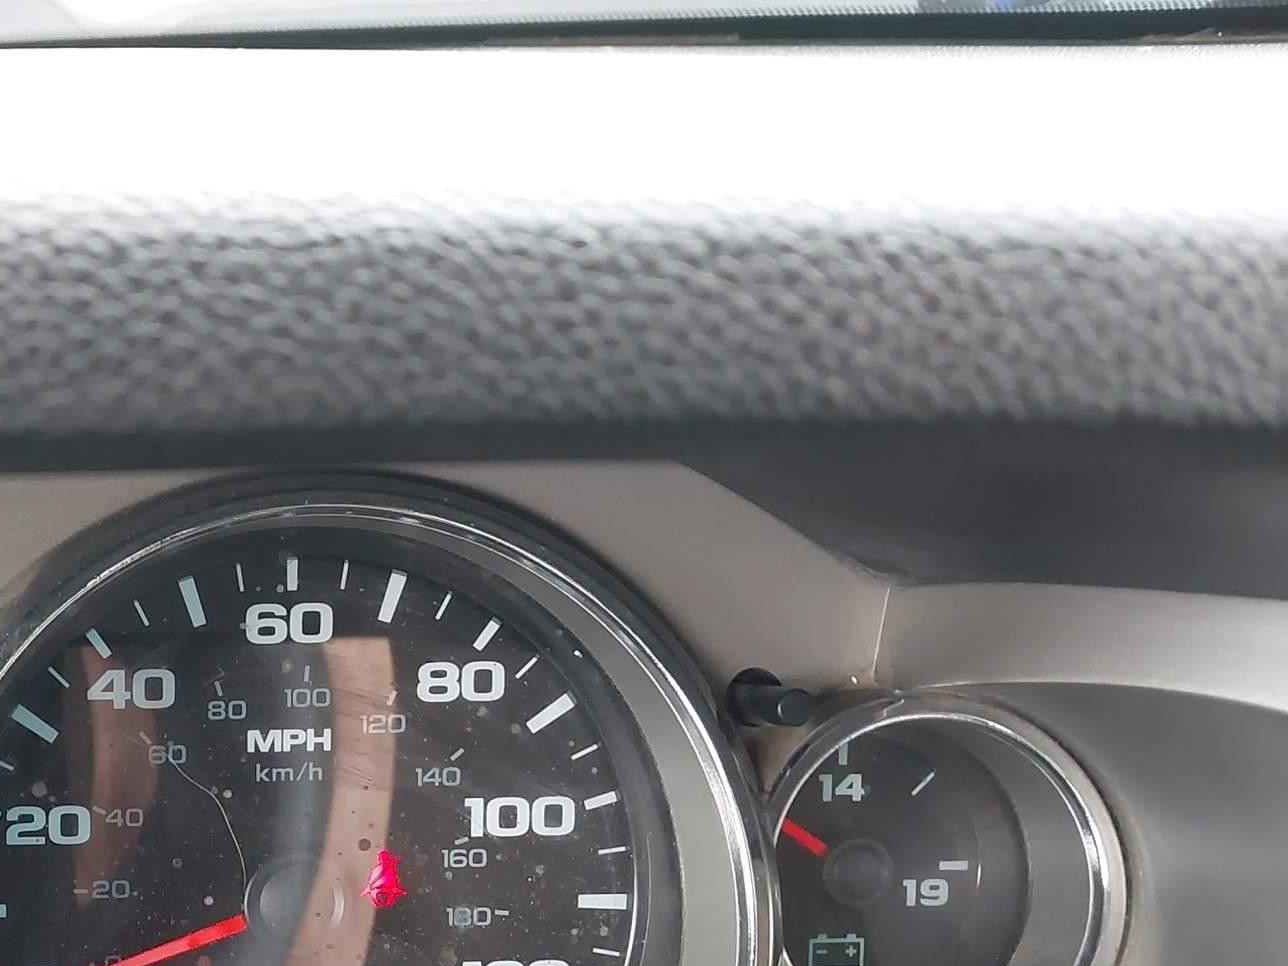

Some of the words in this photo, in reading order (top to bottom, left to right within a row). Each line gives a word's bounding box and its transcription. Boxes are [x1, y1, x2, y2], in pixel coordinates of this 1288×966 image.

[245, 603, 333, 644] 60
[86, 668, 176, 709] 40
[416, 661, 505, 703] 80
[285, 688, 331, 708] 100
[208, 701, 247, 721] 80
[361, 714, 407, 735] 120
[247, 729, 332, 752] MPH
[148, 743, 187, 765] 60
[255, 762, 324, 783] km/h
[416, 768, 462, 788] 140
[819, 773, 865, 802] 14
[6, 804, 92, 845] 20
[105, 808, 144, 828] 40
[464, 797, 576, 838] 100
[442, 849, 487, 869] 160
[92, 880, 130, 899] 20
[903, 878, 949, 907] 19
[446, 907, 492, 927] 180
